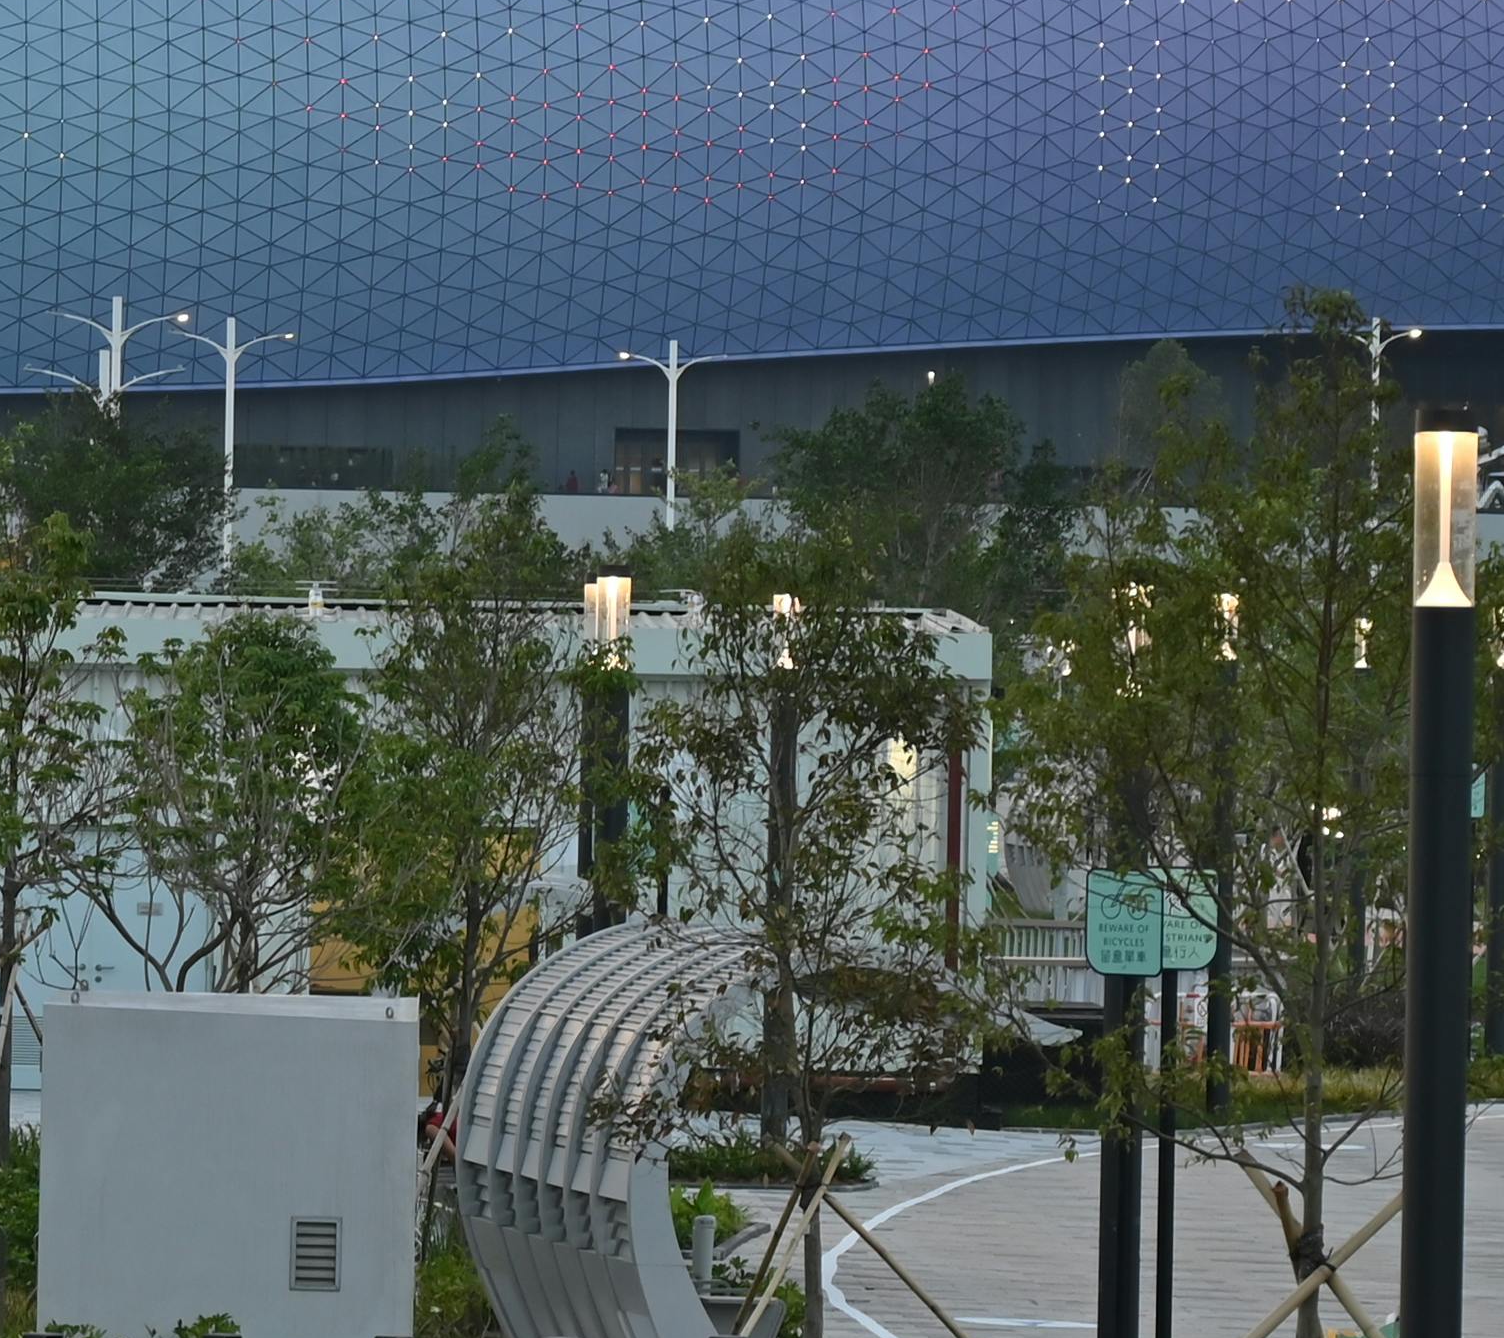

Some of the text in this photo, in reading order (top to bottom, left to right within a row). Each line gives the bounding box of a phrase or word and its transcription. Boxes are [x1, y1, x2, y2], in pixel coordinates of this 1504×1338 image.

[1098, 923, 1149, 934] BEWARE OF
[1103, 937, 1145, 947] BICYCLES
